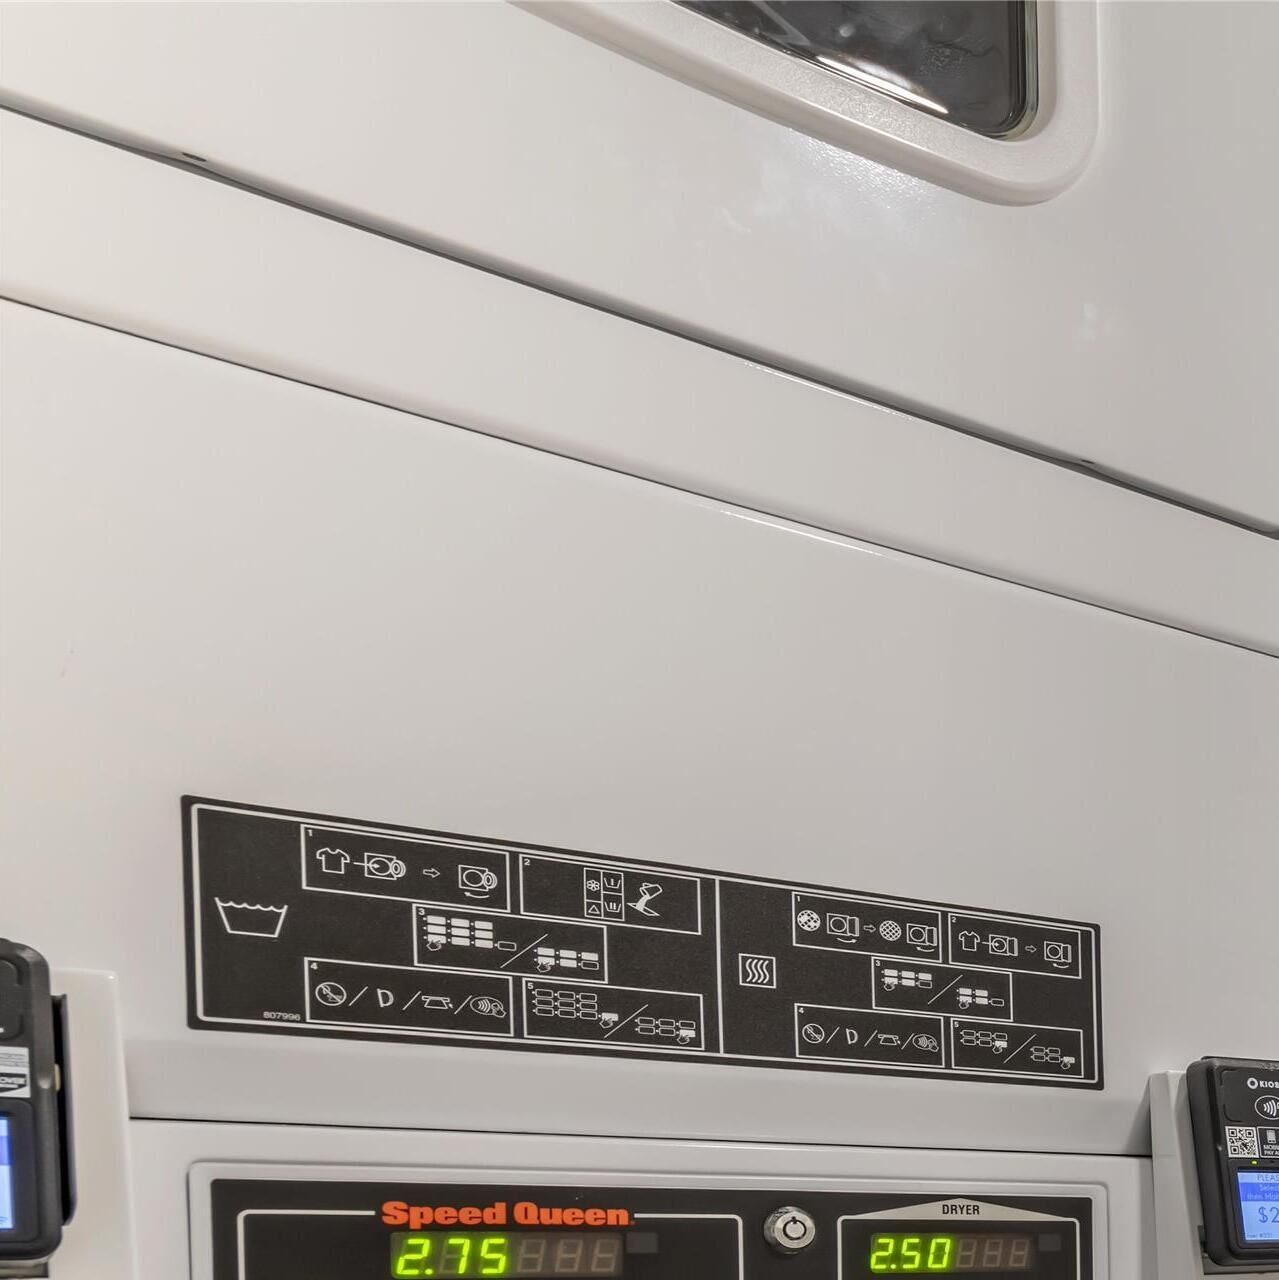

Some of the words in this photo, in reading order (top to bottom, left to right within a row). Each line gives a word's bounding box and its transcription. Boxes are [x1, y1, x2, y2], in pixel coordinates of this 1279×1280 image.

[381, 1200, 507, 1230] Speed
[513, 1201, 629, 1226] Queen
[942, 1204, 980, 1215] DRYER
[396, 1237, 507, 1276] 2.75
[870, 1237, 951, 1270] 2.50
